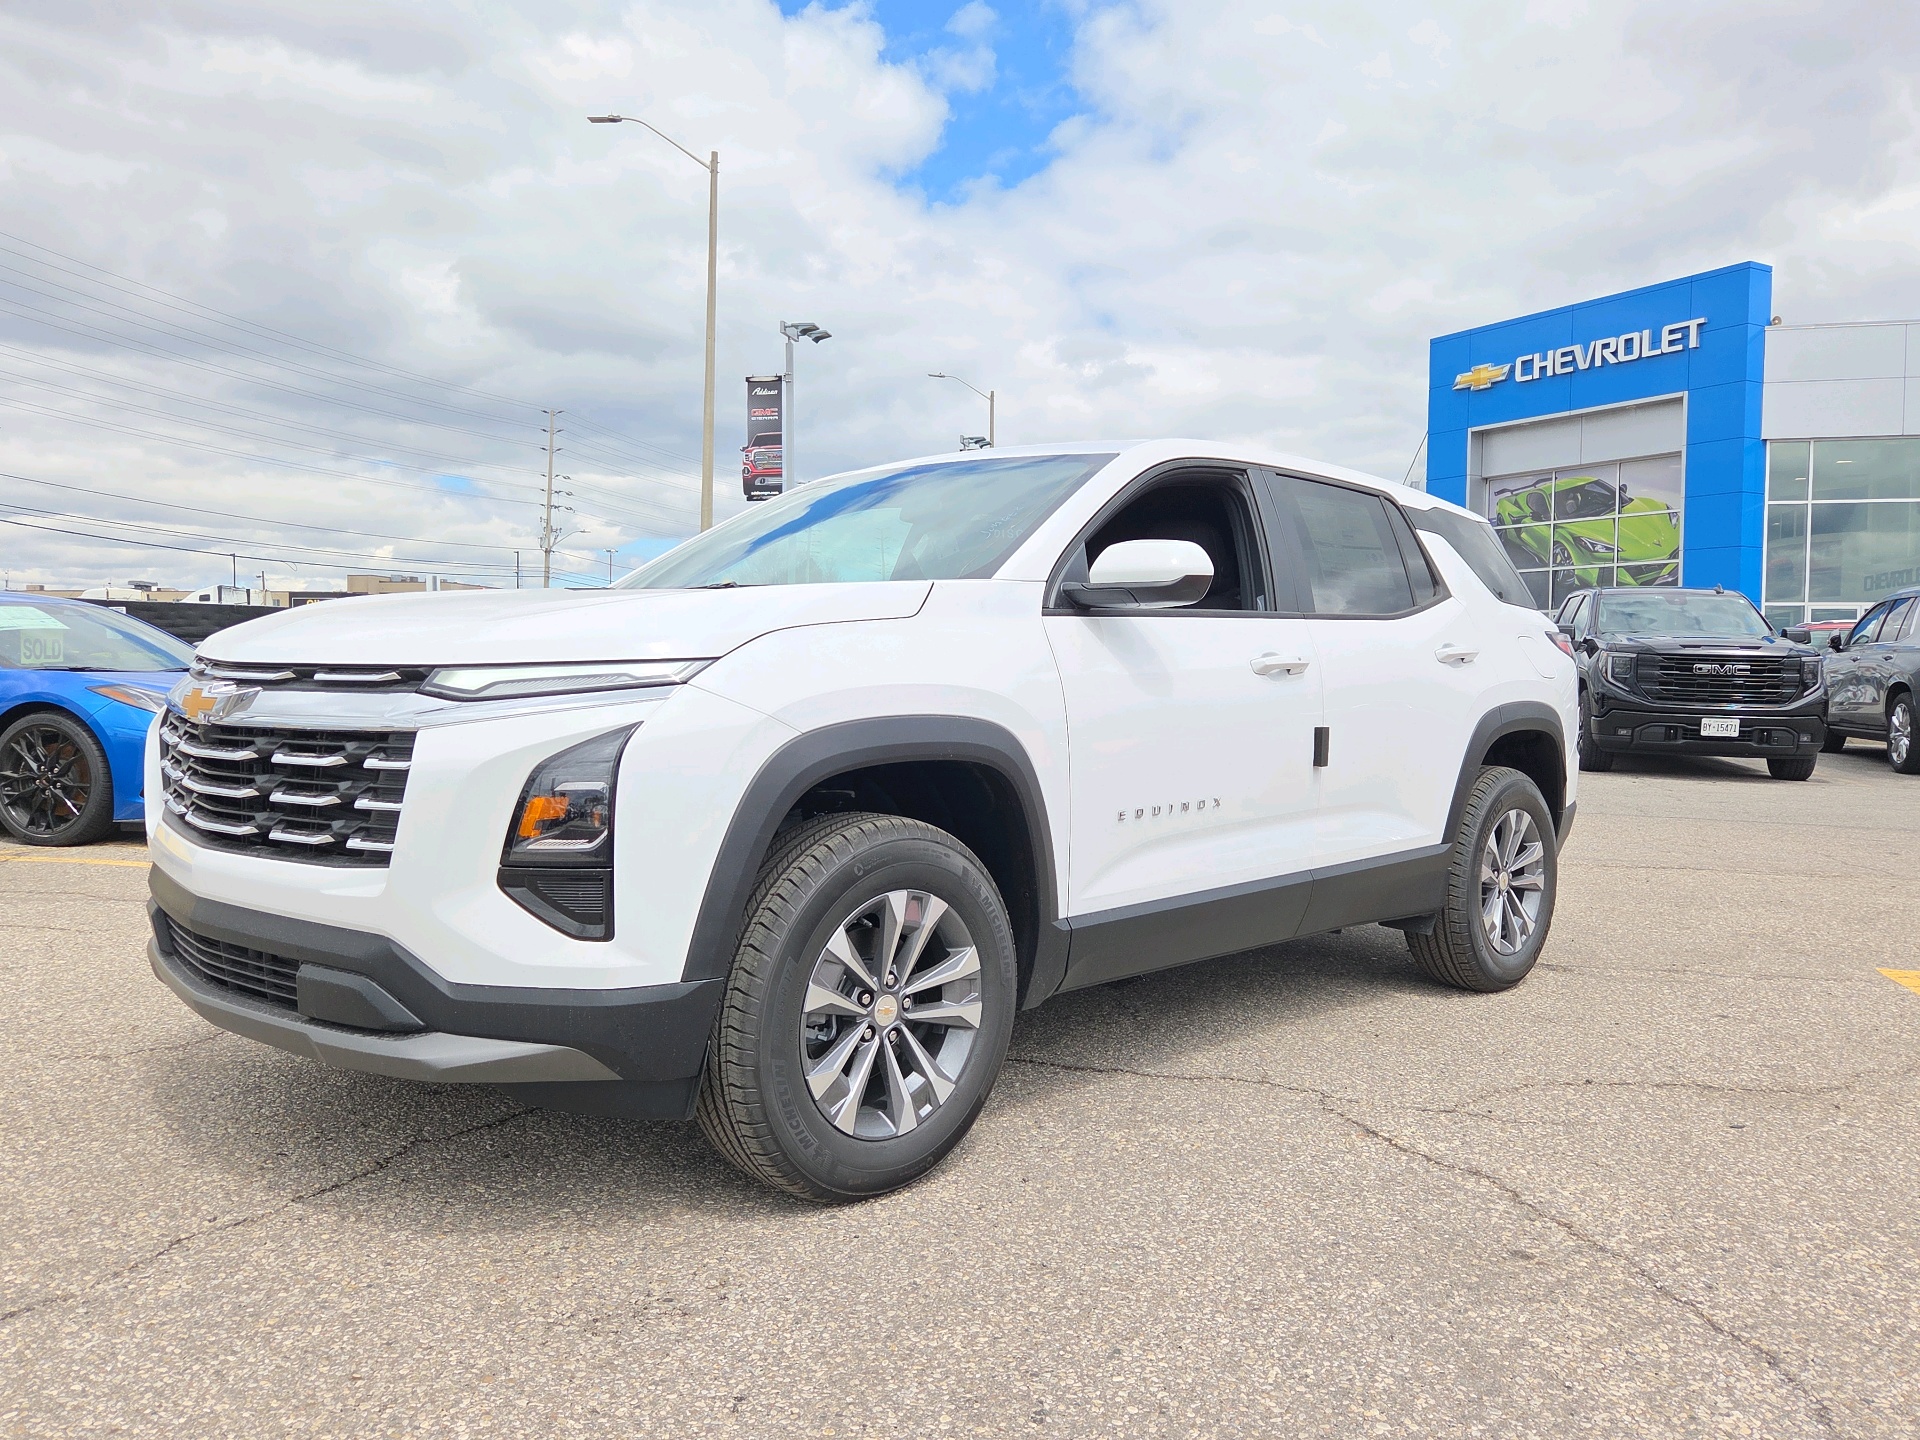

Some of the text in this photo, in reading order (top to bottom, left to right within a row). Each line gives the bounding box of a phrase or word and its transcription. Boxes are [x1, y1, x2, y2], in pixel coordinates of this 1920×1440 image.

[1515, 317, 1708, 383] CHEVROLET
[751, 407, 779, 416] GMC
[22, 637, 62, 660] SOLD
[1693, 663, 1751, 676] GMC
[1117, 797, 1221, 822] EQUINOX
[982, 894, 1011, 974] MICHELIN
[774, 1063, 816, 1152] MICHELIN
